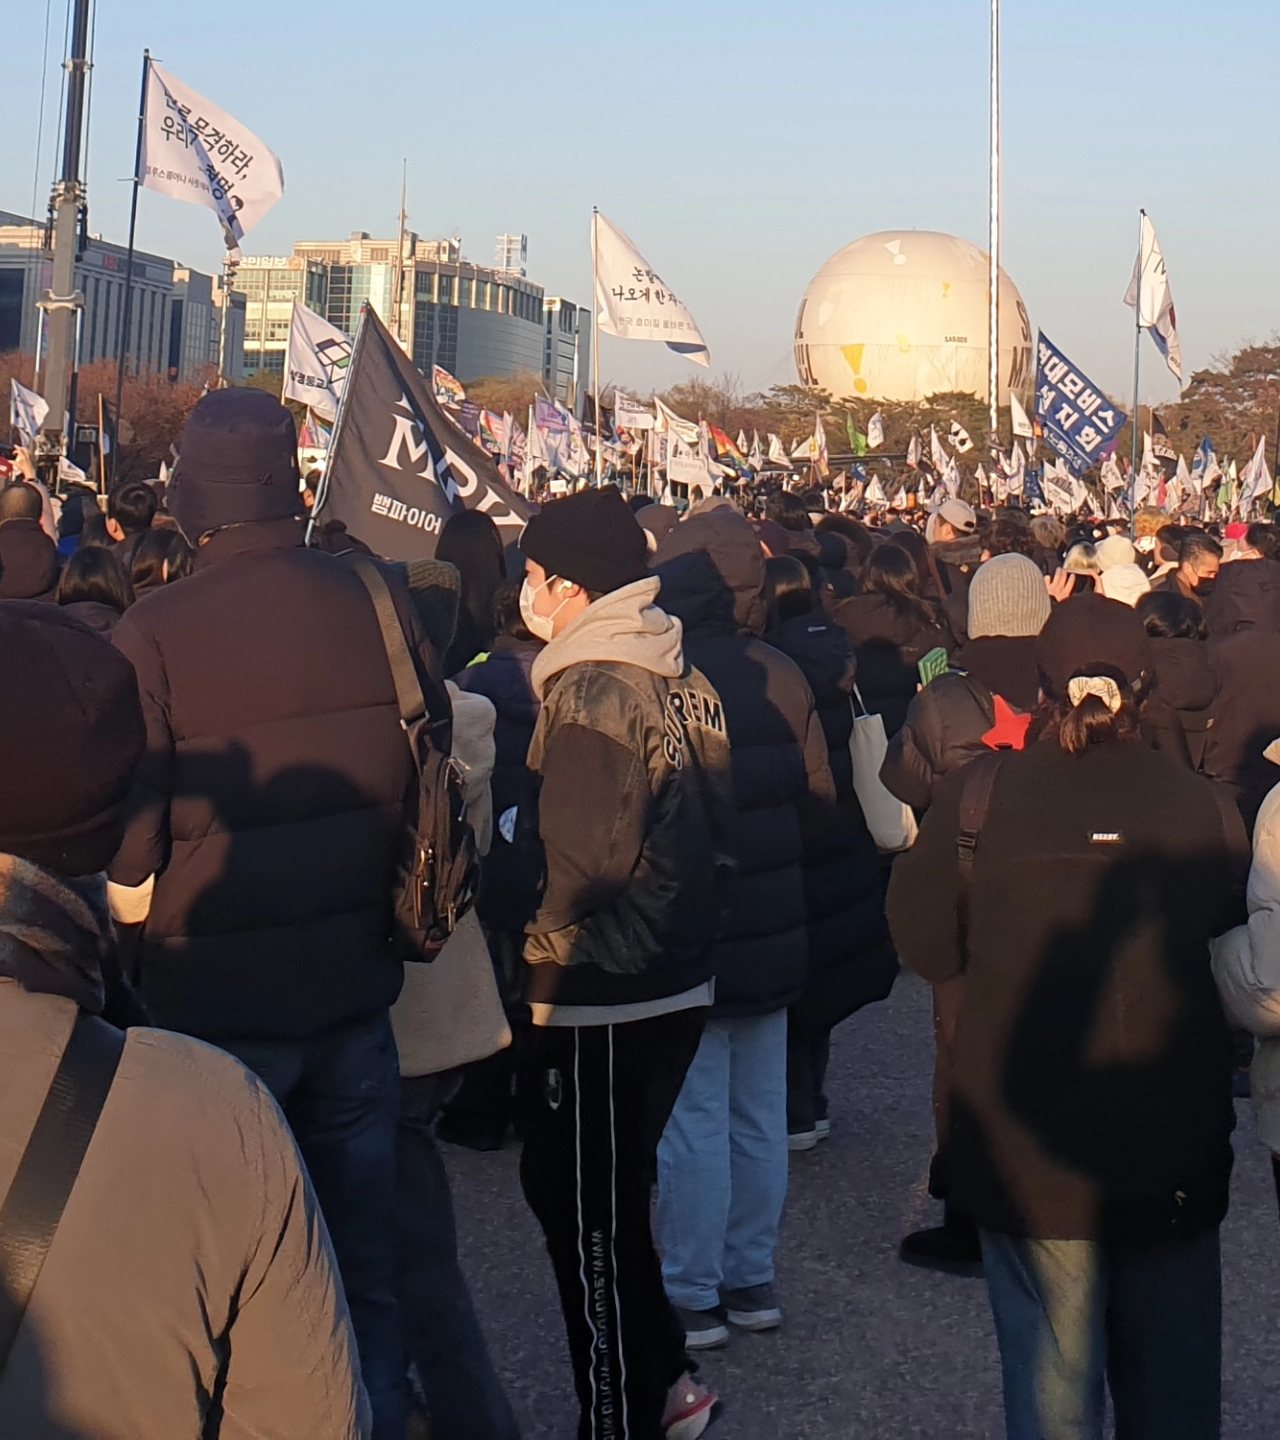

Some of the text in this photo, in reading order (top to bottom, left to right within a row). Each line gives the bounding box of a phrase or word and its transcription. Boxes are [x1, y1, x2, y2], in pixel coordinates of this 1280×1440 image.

[611, 284, 651, 305] 나오게
[654, 288, 666, 306] 한
[371, 492, 442, 536] 뱀파이어
